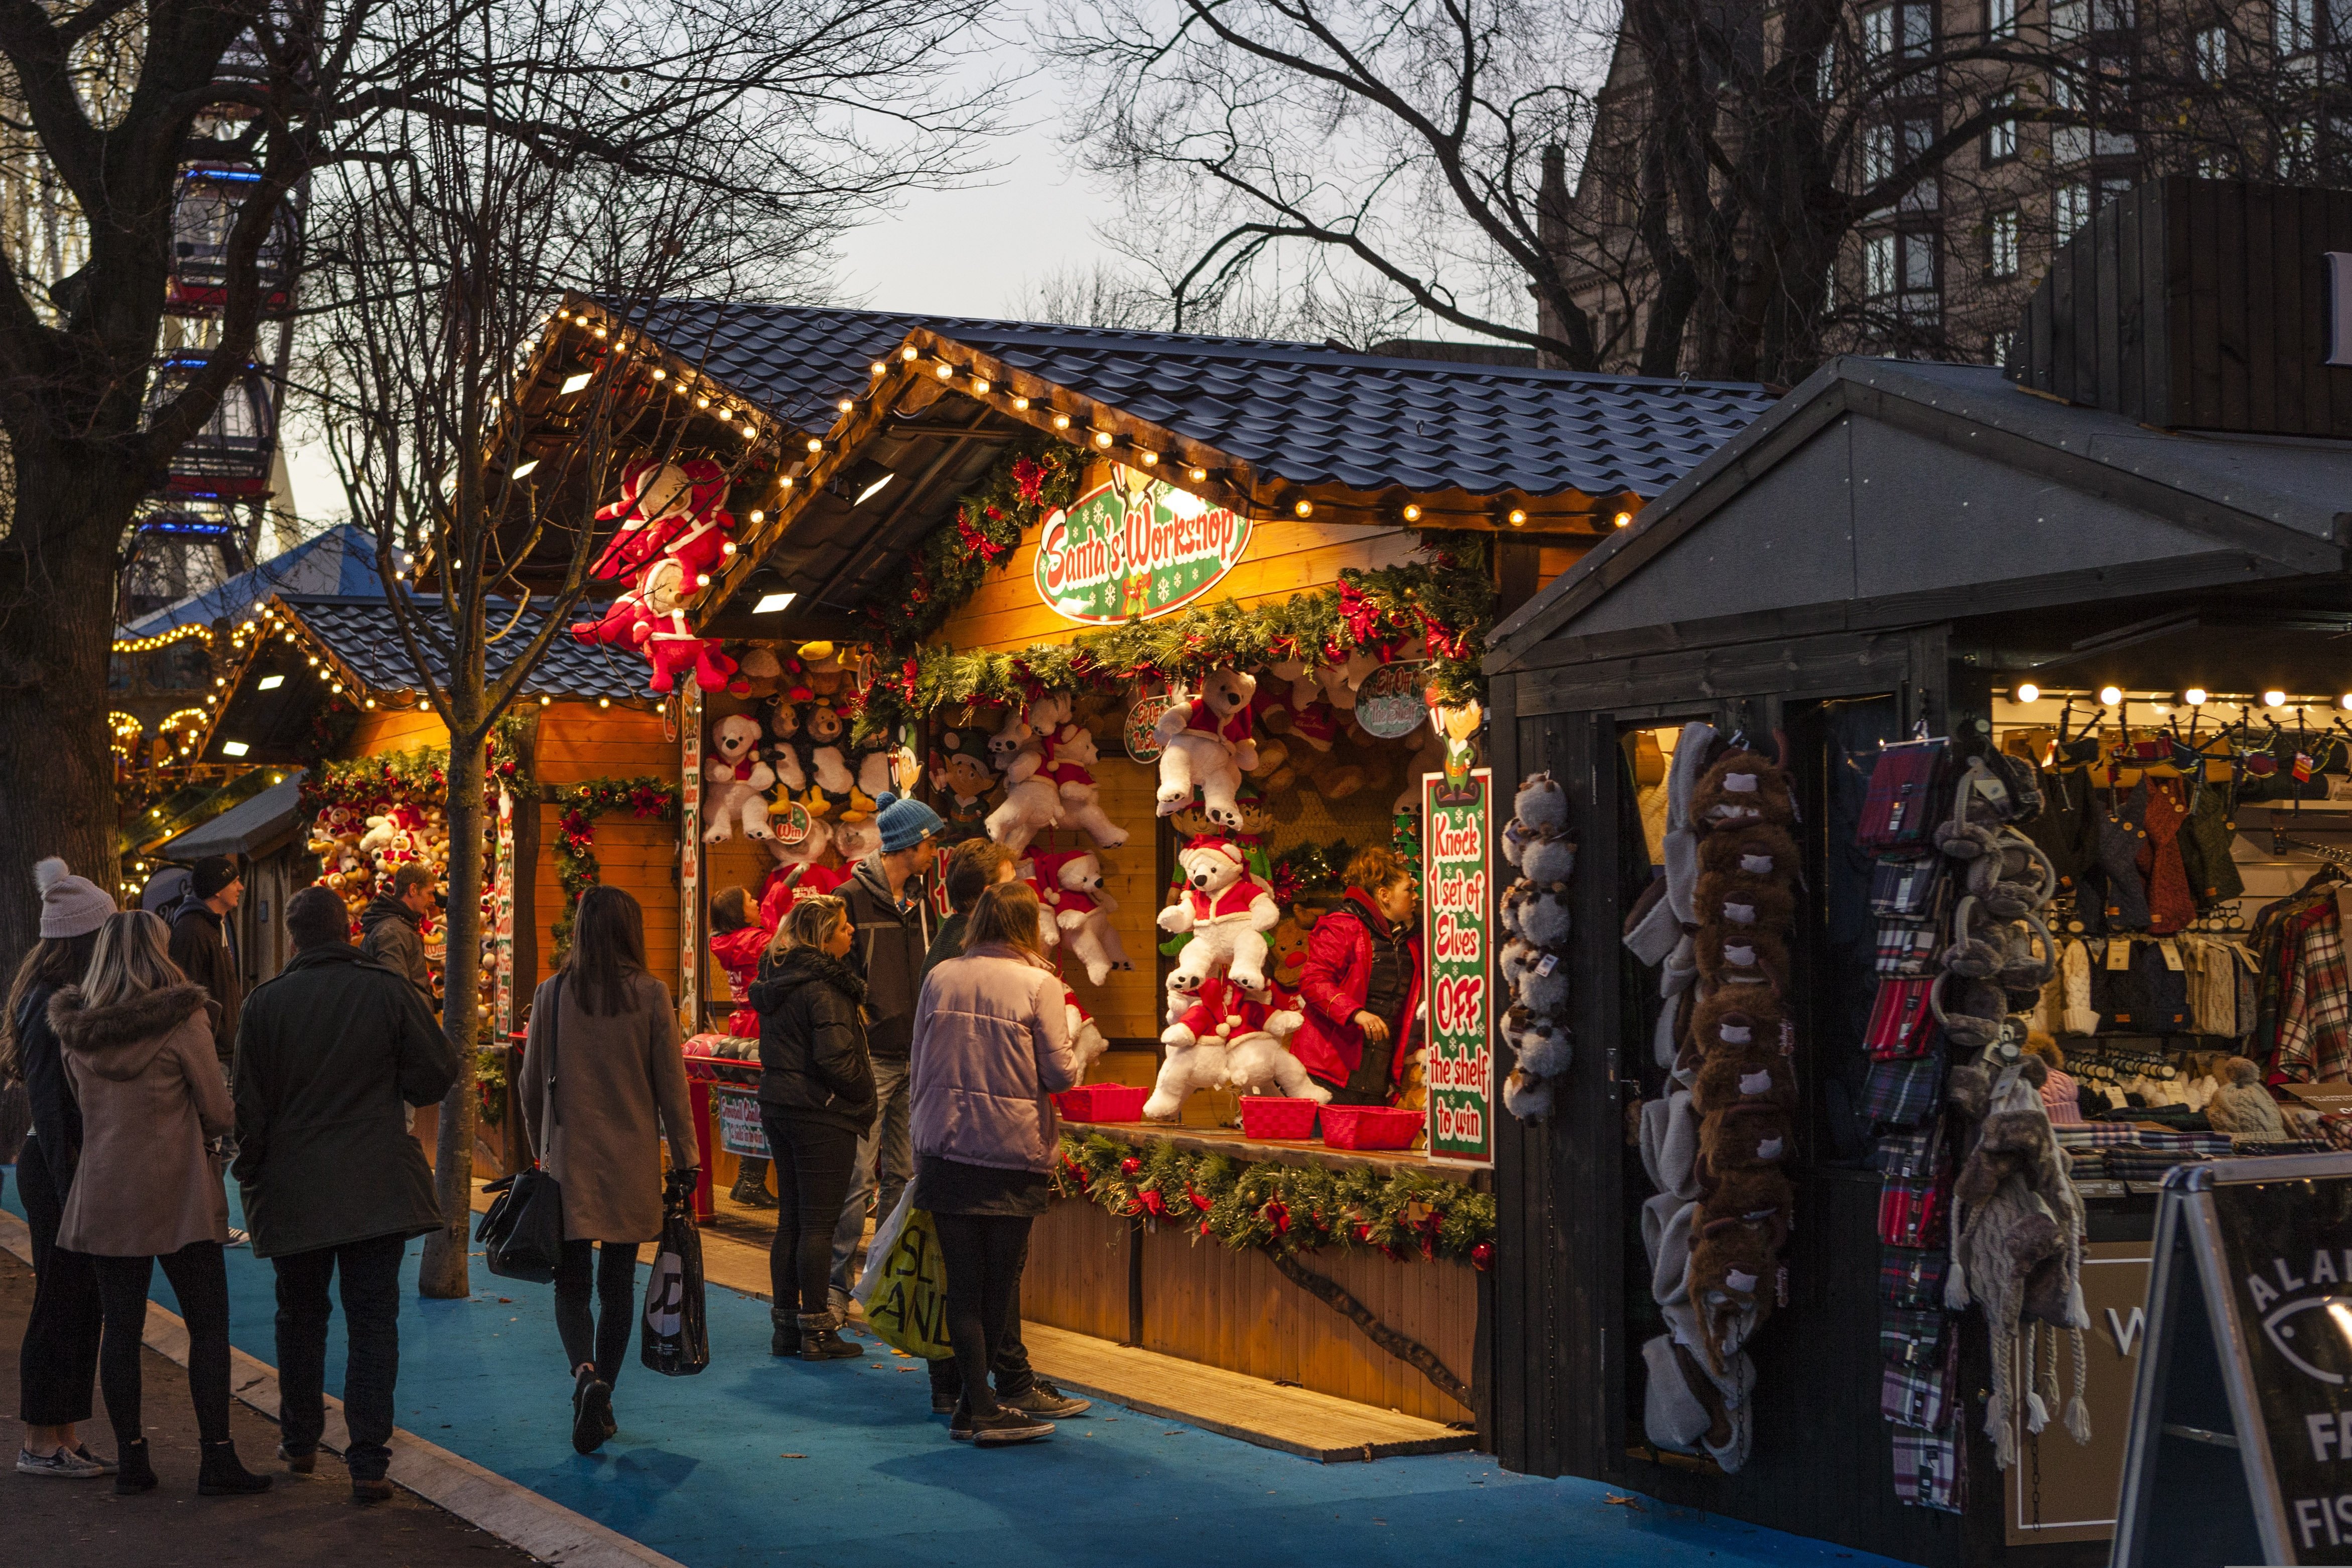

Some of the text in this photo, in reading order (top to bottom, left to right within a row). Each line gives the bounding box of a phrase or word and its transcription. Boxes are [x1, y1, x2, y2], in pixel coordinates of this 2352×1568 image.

[1047, 499, 1235, 590] Santa's Workshop
[1133, 731, 1145, 751] The
[777, 822, 801, 837] Win
[1434, 813, 1479, 857] Knock
[1431, 865, 1482, 916] 1 set of
[1436, 914, 1477, 957] Elves
[1429, 1044, 1489, 1096] the shelf
[1438, 1100, 1479, 1136] to win
